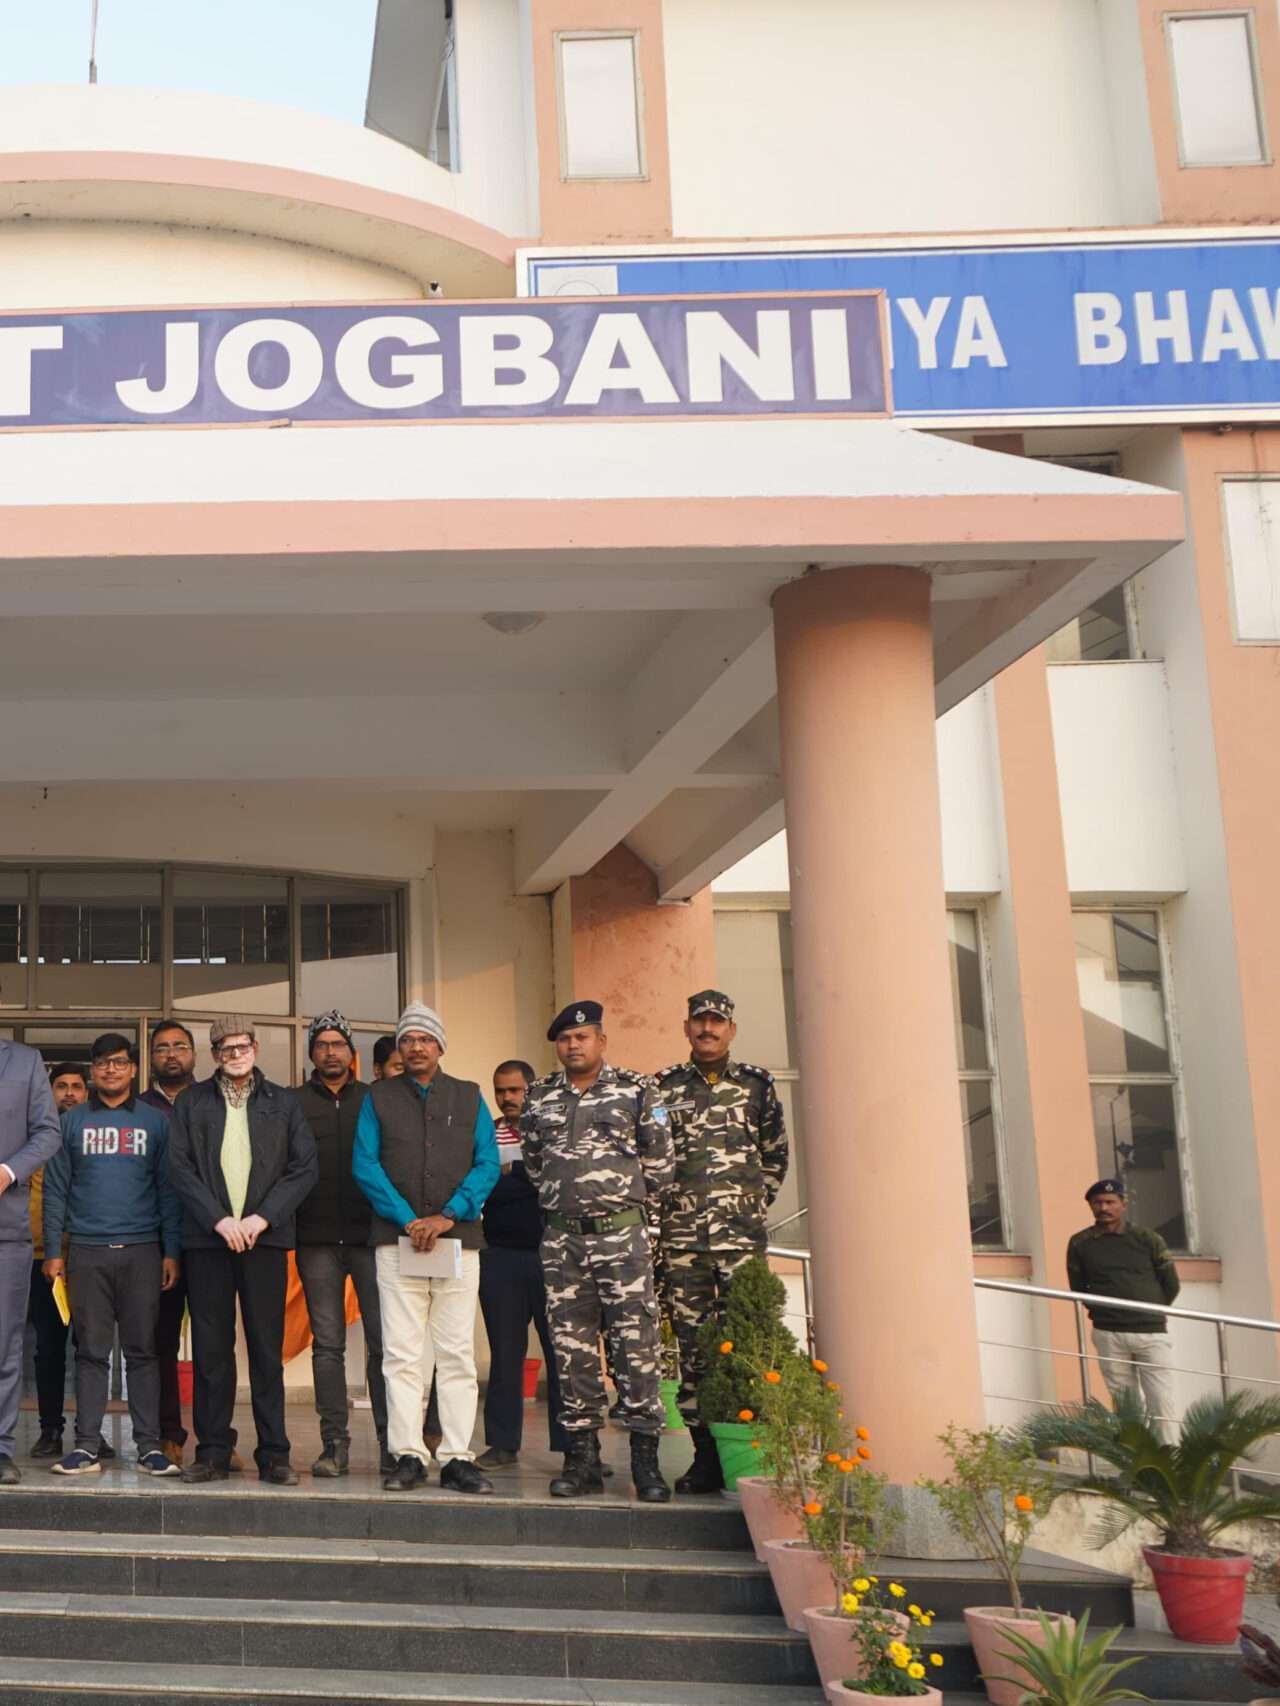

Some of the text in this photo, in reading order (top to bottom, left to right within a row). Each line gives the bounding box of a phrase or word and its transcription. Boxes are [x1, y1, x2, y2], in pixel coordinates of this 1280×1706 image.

[115, 307, 852, 415] JOGBANI
[886, 296, 1008, 369] YA
[82, 1127, 148, 1156] RIDER
